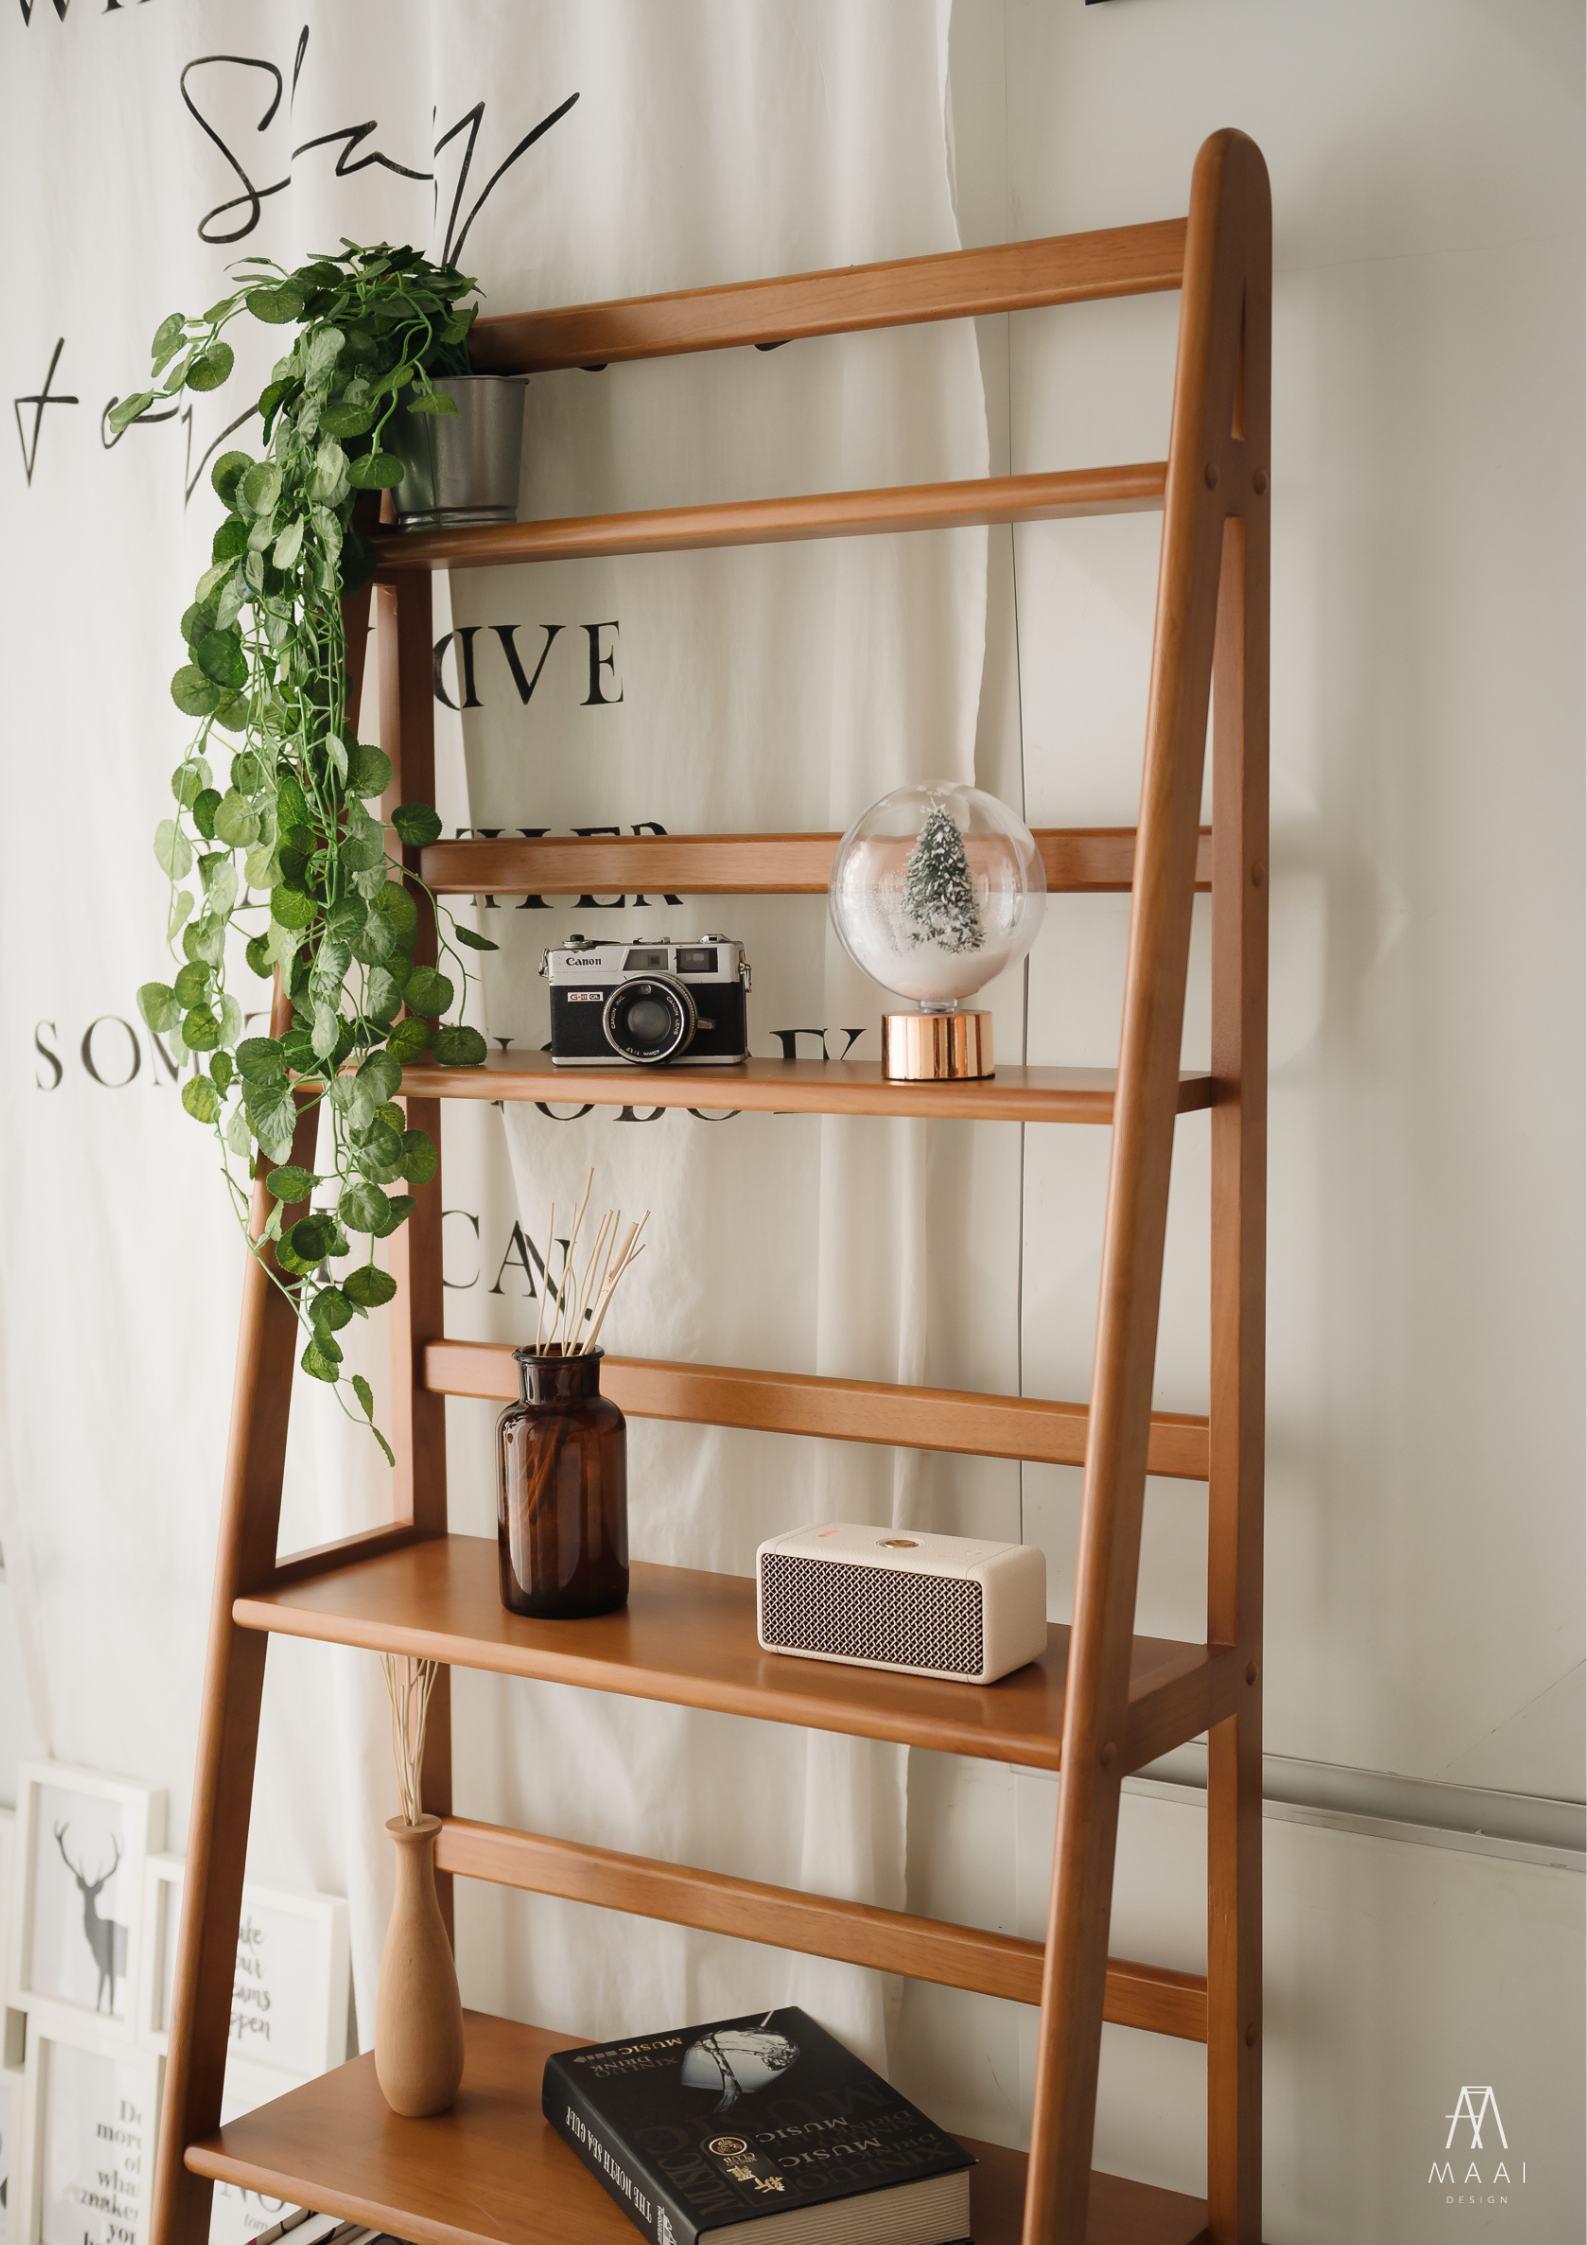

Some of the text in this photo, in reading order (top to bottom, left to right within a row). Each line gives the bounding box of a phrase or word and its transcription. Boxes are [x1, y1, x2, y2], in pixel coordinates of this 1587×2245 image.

[566, 957, 602, 966] Canon
[666, 996, 680, 1017] CANON
[619, 2037, 683, 2056] MUSIC
[755, 2116, 850, 2143] MUSIC
[587, 2129, 603, 2163] SEA
[778, 2137, 883, 2168] MUSIC
[603, 2149, 632, 2200] NORTH
[633, 2186, 652, 2224] THE
